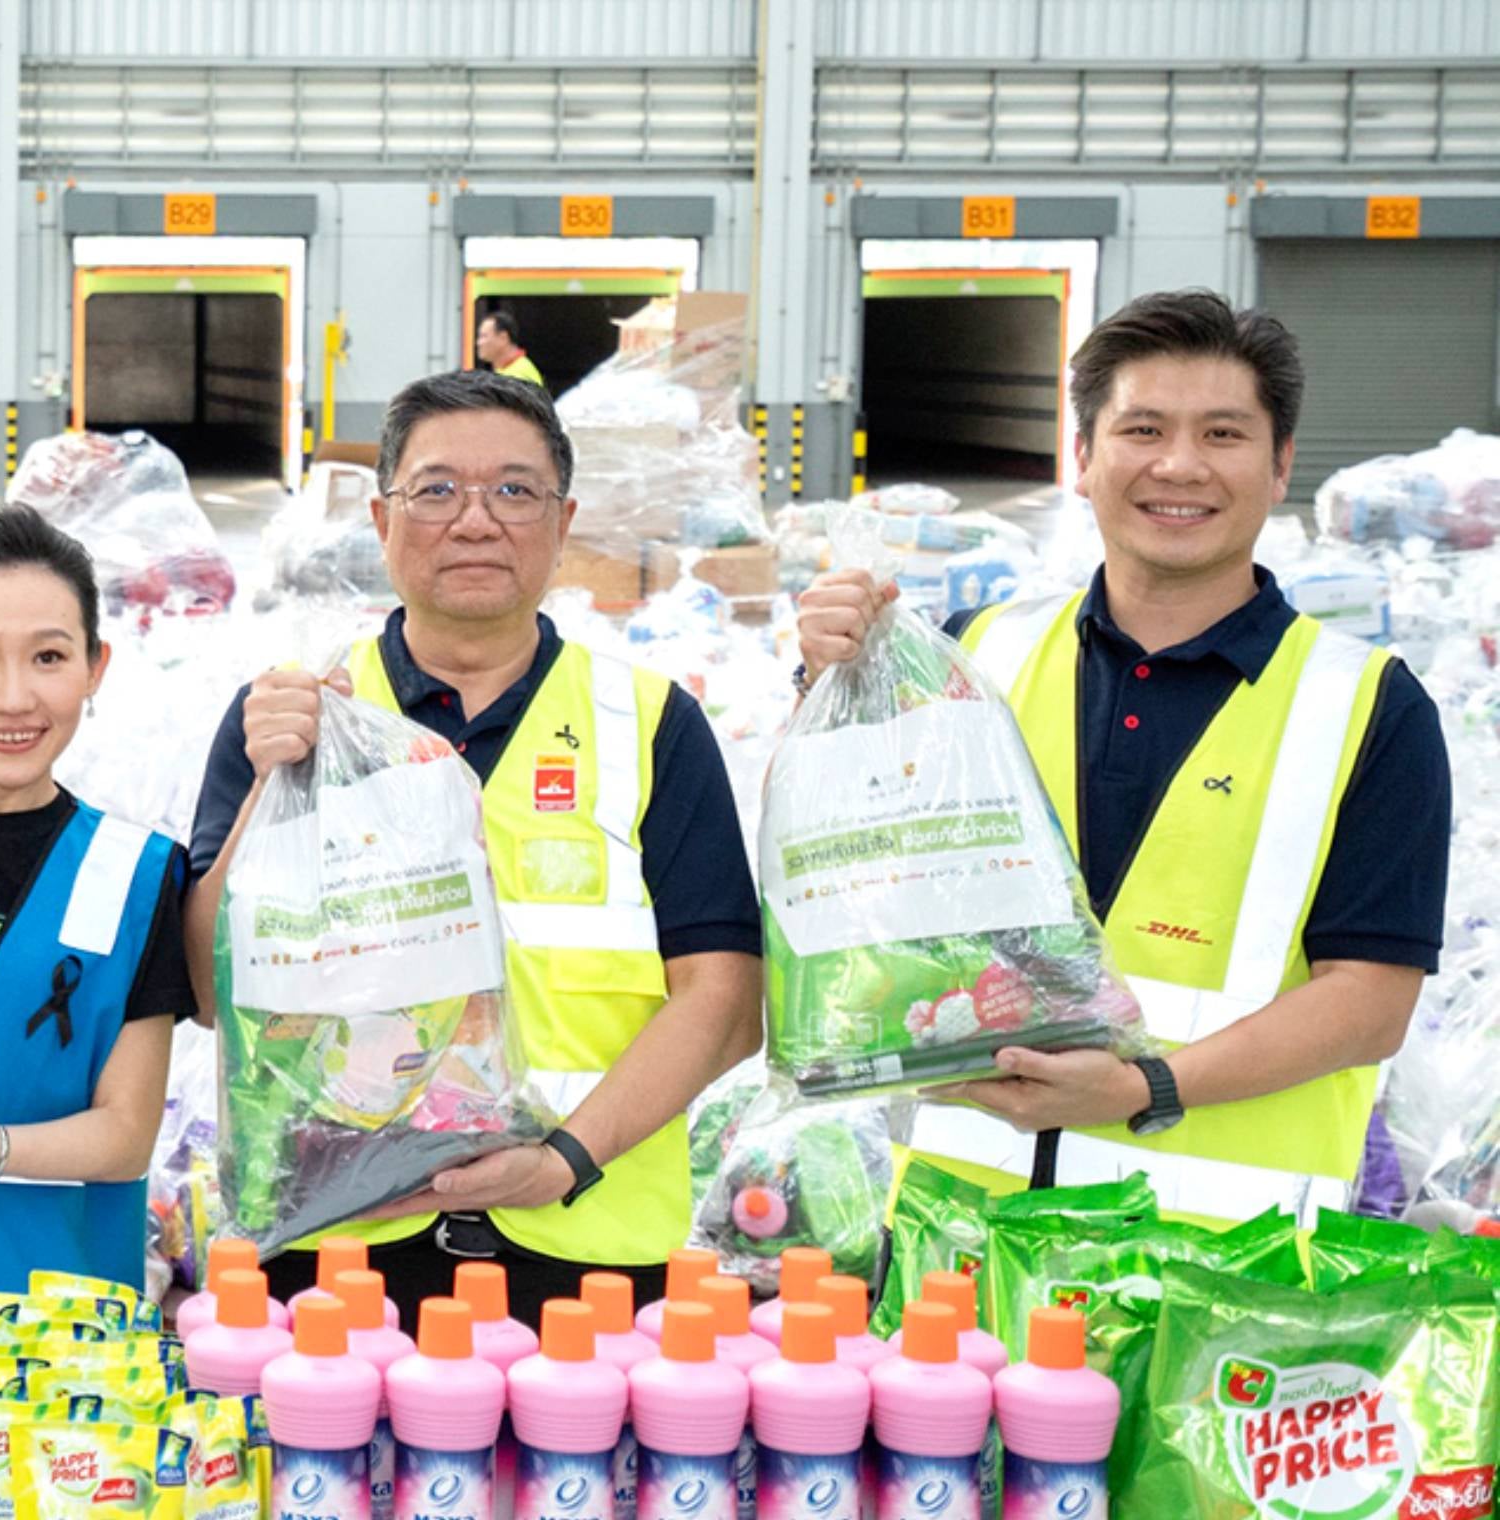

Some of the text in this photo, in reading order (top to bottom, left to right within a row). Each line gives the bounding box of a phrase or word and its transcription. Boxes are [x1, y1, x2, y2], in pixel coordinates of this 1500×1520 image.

[169, 203, 211, 226] B29
[565, 205, 608, 227] B30
[967, 206, 1009, 228] B31
[1370, 206, 1413, 228] B32
[1147, 920, 1201, 944] DHL
[1244, 1388, 1385, 1457] HAPPY
[49, 1451, 98, 1470] HAPPY
[1254, 1422, 1399, 1500] PRICE
[51, 1464, 99, 1485] PRICE
